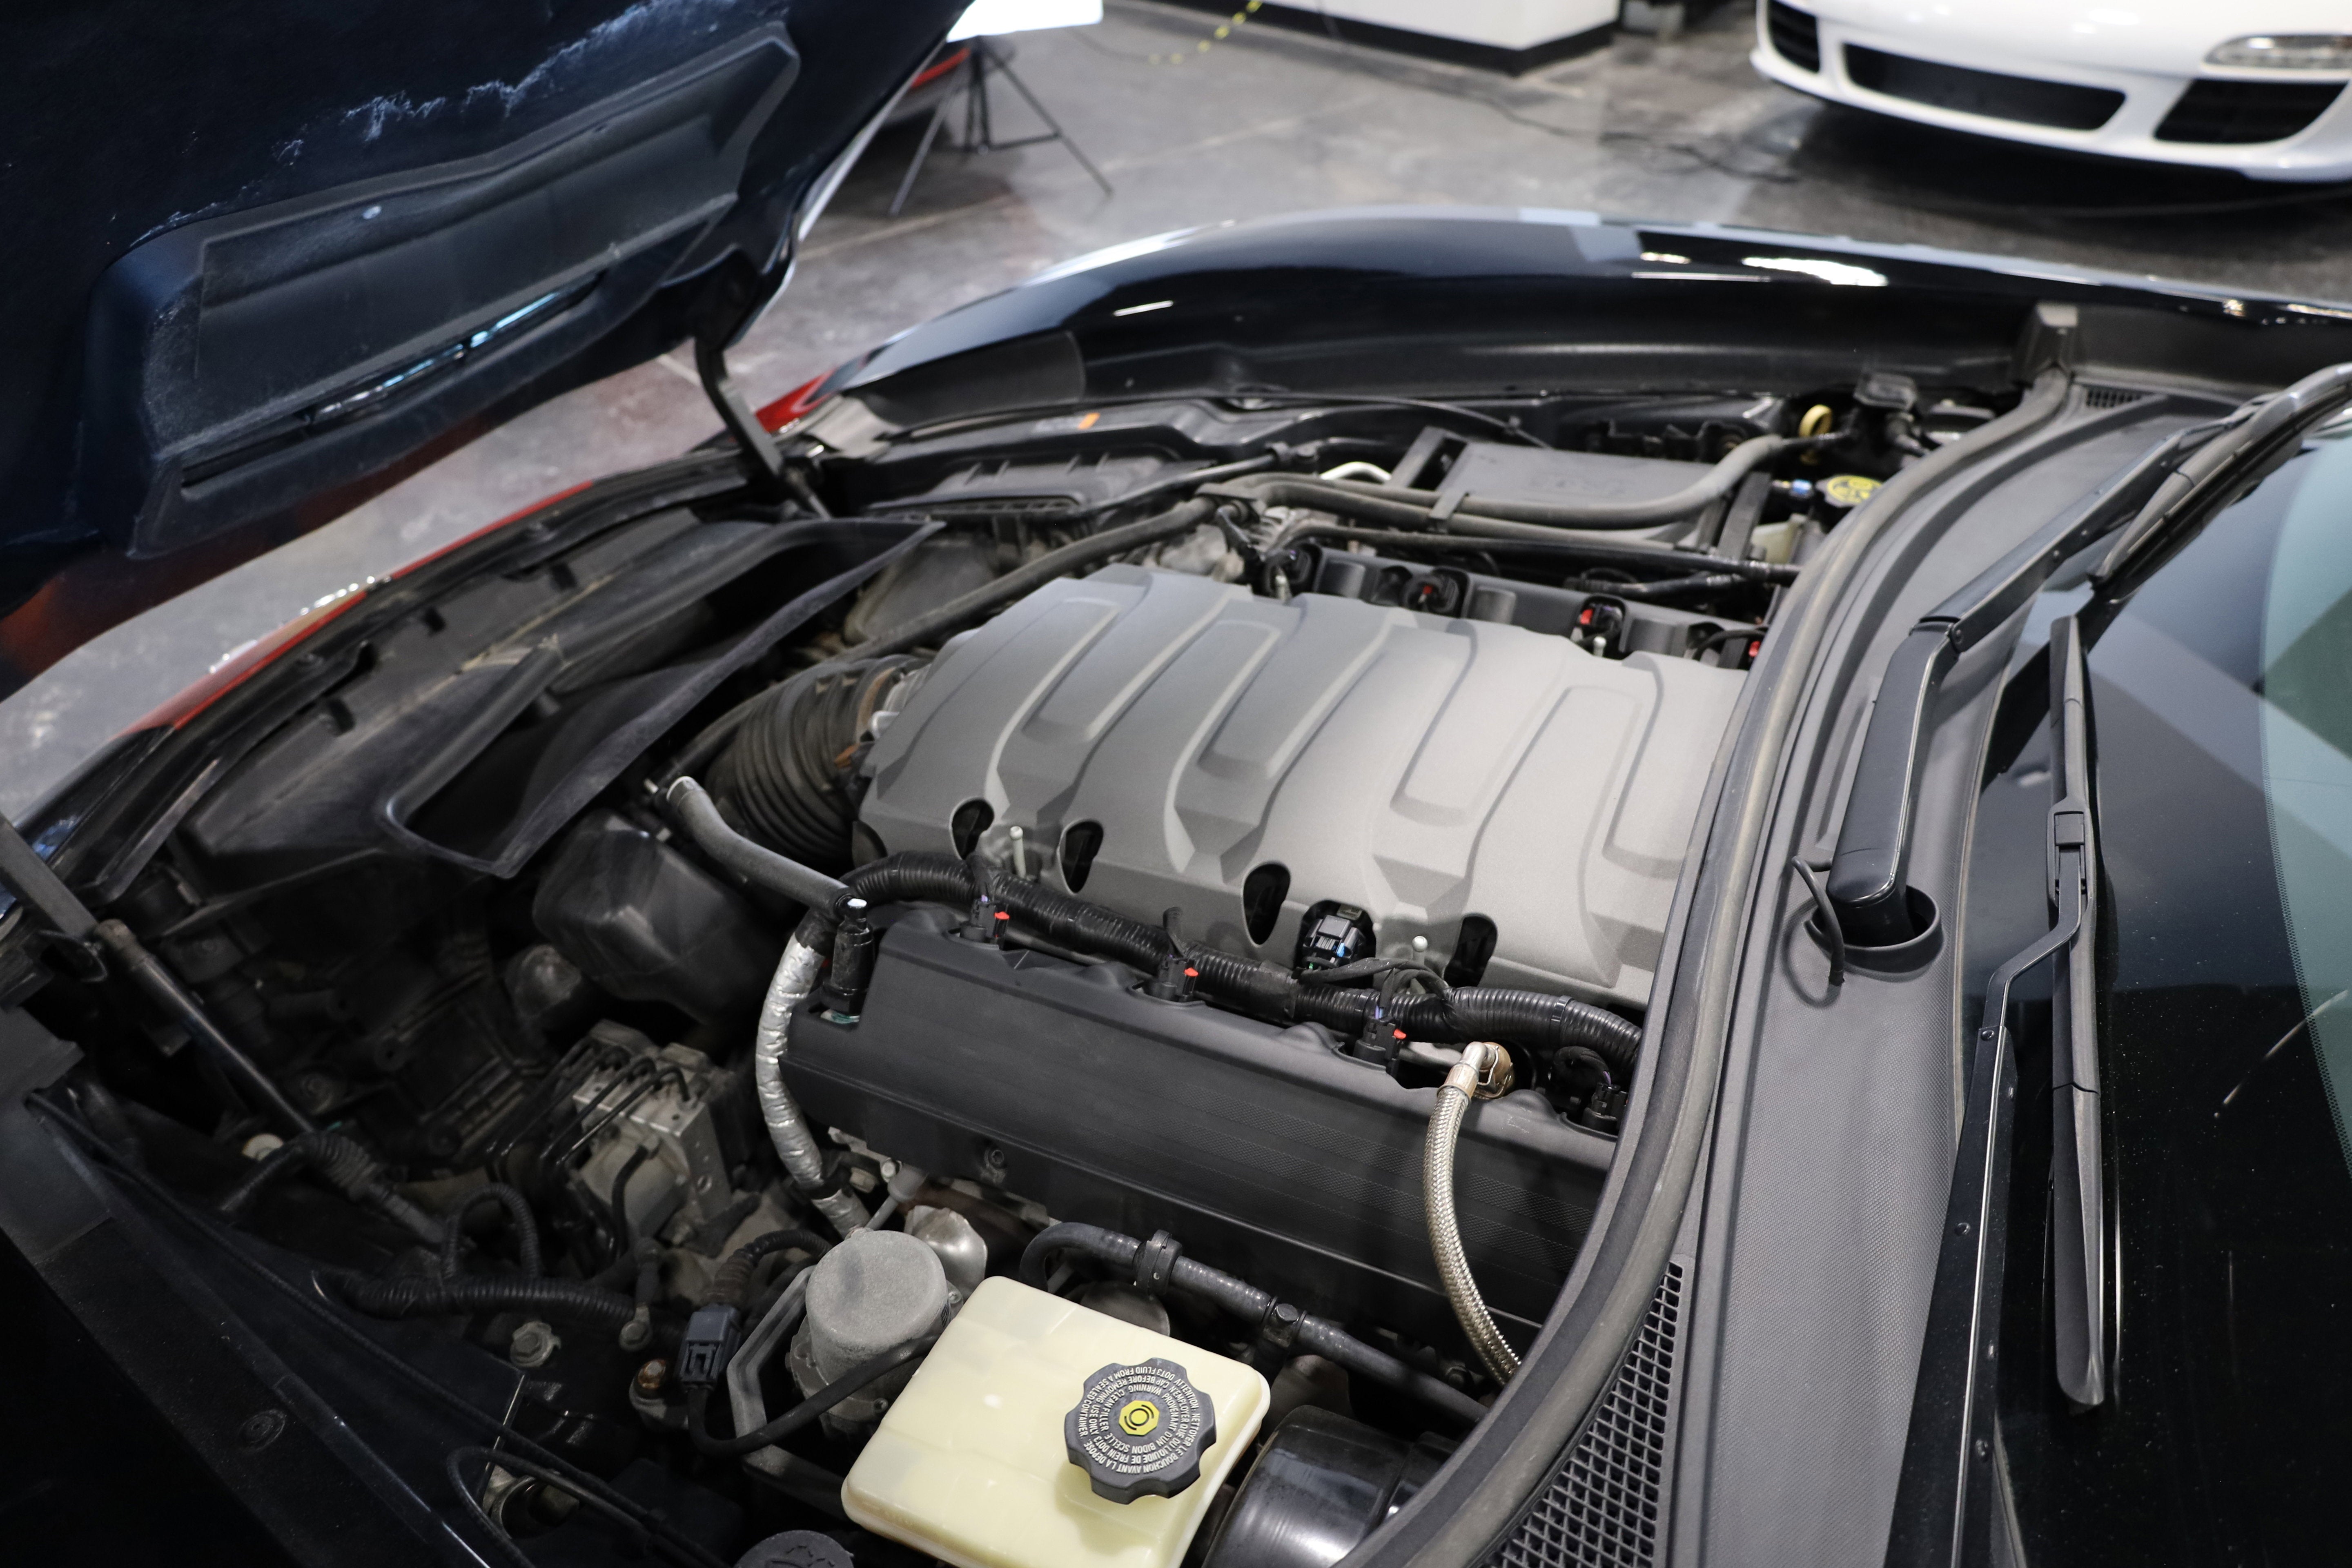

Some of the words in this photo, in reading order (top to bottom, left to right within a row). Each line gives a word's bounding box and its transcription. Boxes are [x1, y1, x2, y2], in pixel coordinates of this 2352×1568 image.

[1114, 1368, 1134, 1379] FROM
[1128, 1375, 1156, 1384] BEFORE
[1087, 1379, 1109, 1400] SEALED
[1156, 1379, 1169, 1388] CAP
[1104, 1389, 1125, 1408] CLEAN
[1169, 1385, 1189, 1422] N'EMPLOYER
[1089, 1405, 1100, 1418] USE
[1099, 1407, 1110, 1431] FILLER
[1161, 1393, 1179, 1432] PROVENANT
[1089, 1419, 1099, 1435] ONLY
[1176, 1424, 1188, 1439] QUE
[1183, 1413, 1200, 1447] NETTOYER
[1104, 1432, 1131, 1452] SCELLE
[1156, 1431, 1173, 1446] D'UN
[1169, 1437, 1181, 1448] DU
[1107, 1448, 1130, 1463] FREIN
[1131, 1442, 1156, 1454] BIDON
[1143, 1445, 1172, 1463] LIQUIDE
[1175, 1445, 1187, 1456] LE
[1106, 1459, 1117, 1470] LA
[1131, 1455, 1141, 1464] DE
[1143, 1452, 1179, 1473] BOUCHON
[1116, 1463, 1142, 1473] AVANT
